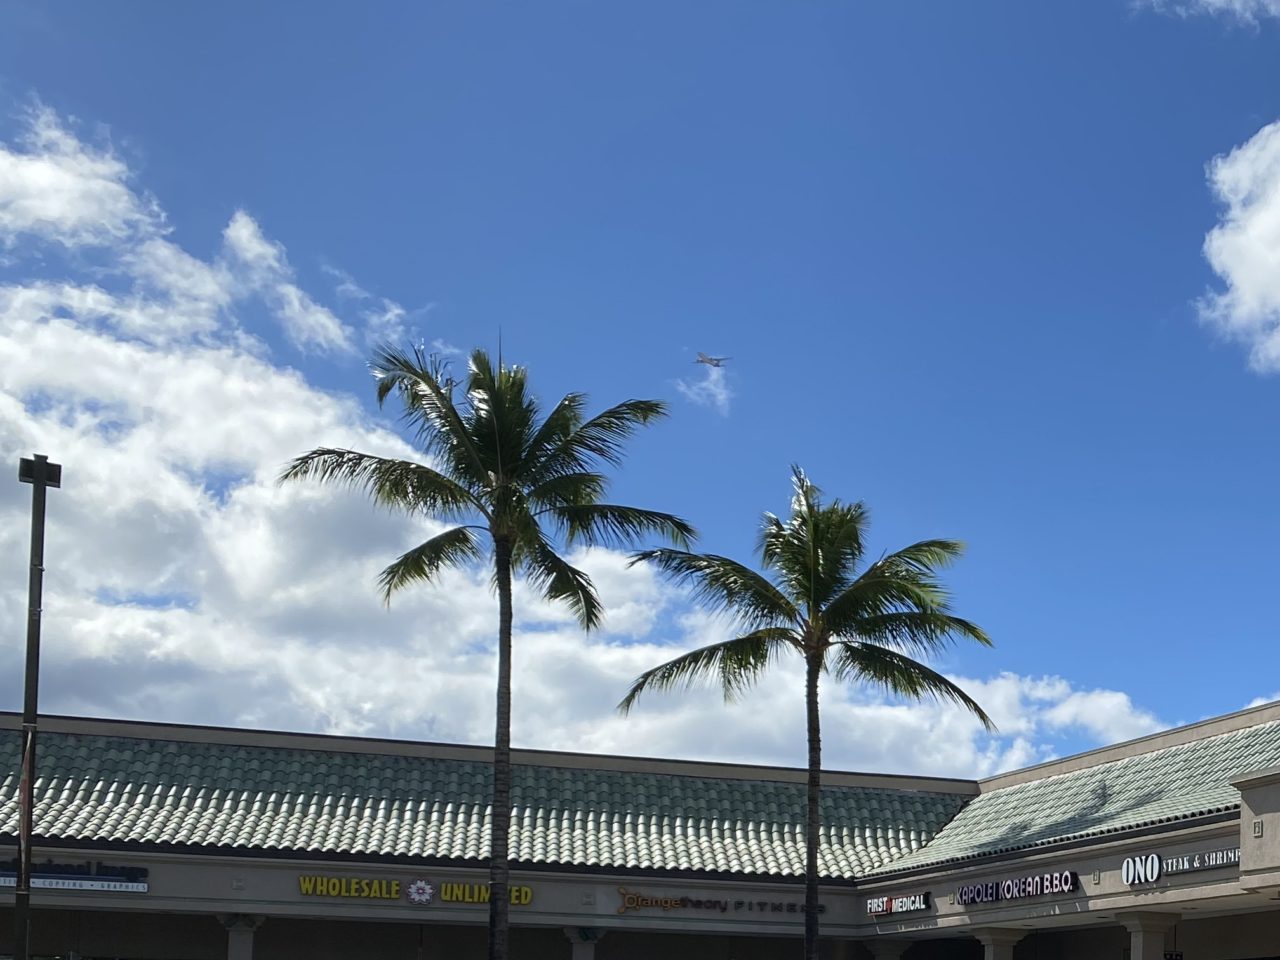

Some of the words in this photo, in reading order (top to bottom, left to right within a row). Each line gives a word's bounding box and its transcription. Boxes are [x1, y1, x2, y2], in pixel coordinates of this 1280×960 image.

[1121, 853, 1161, 886] ONO
[1163, 856, 1190, 873] STEAK
[1193, 854, 1201, 869] &
[1204, 848, 1240, 867] SHRIMP
[299, 875, 400, 900] WHOLESALE
[440, 882, 533, 906] UNLIMED
[956, 882, 996, 905] KAPOLEI
[998, 875, 1041, 900] KOREAN
[1043, 870, 1073, 895] B.B.Q.
[620, 889, 729, 914] Orangetheory
[867, 896, 888, 914] FIRST
[891, 894, 926, 913] MEDICAL
